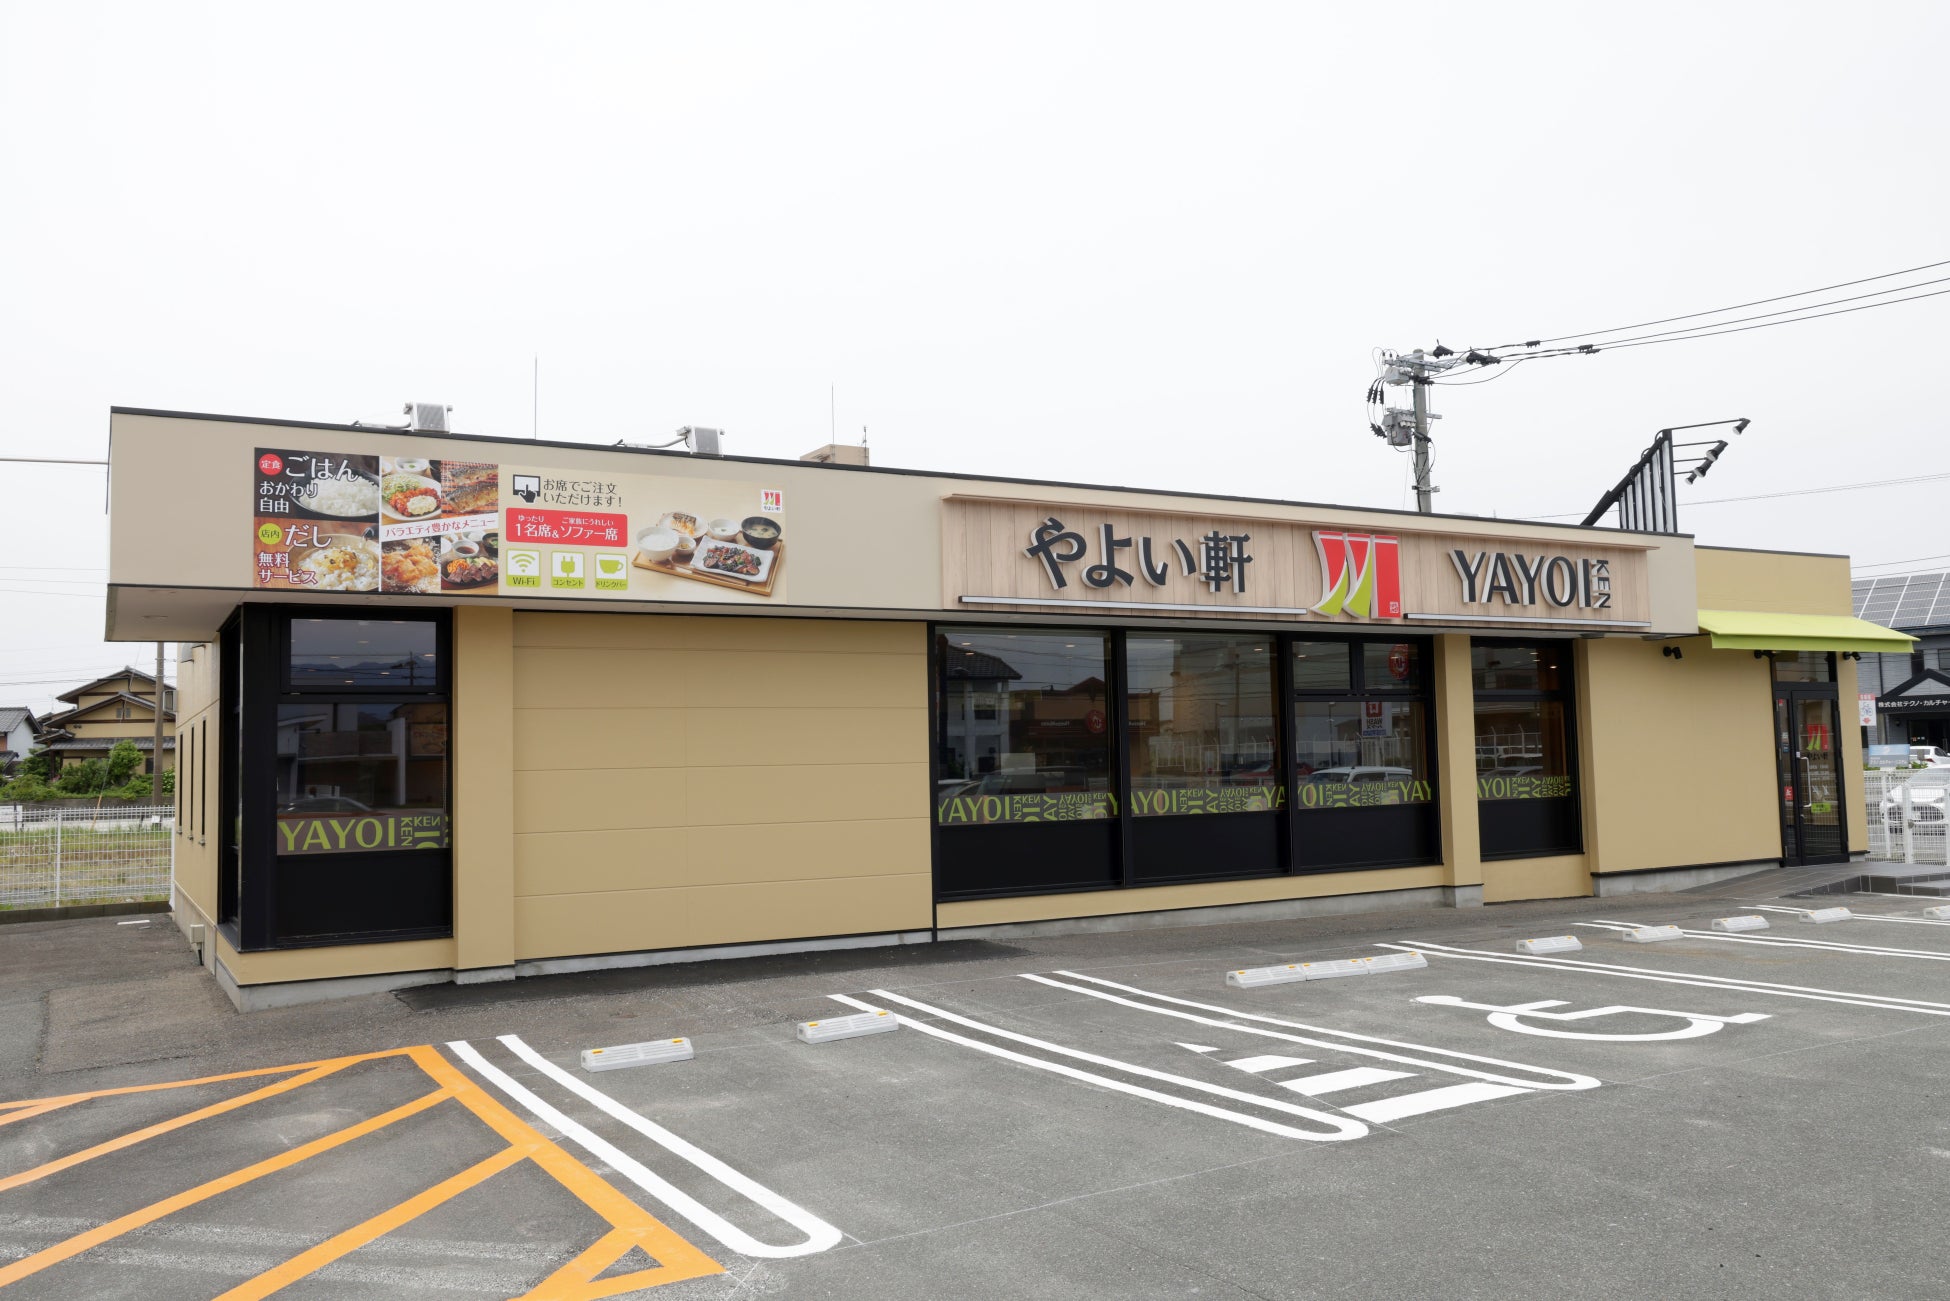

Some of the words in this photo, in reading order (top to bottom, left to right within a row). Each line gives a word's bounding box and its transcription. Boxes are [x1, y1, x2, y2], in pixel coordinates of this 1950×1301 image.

[261, 460, 281, 470] 定食
[285, 455, 360, 482] ごはん
[259, 481, 319, 498] おかわり
[543, 478, 618, 495] お席でご注文
[259, 497, 289, 514] 自由
[543, 492, 622, 508] いただけます！
[518, 514, 544, 522] ゆったり
[562, 517, 615, 526] ご家族にうれしい
[261, 529, 282, 539] 店内
[284, 524, 332, 548] だし
[385, 518, 496, 538] バラエティ豊かなメニュー
[257, 551, 290, 568] 無料
[1022, 516, 1253, 594] やよい軒
[257, 569, 318, 585] サービス
[512, 576, 536, 586] Wi-Fi
[552, 579, 584, 587] コンセント
[595, 580, 626, 588] ドリンクバー
[1448, 549, 1591, 609] YAYOI
[1591, 559, 1611, 609] KEN
[938, 796, 1010, 823] YAYOI
[277, 817, 395, 851] YAYOI
[400, 817, 413, 847] KEN
